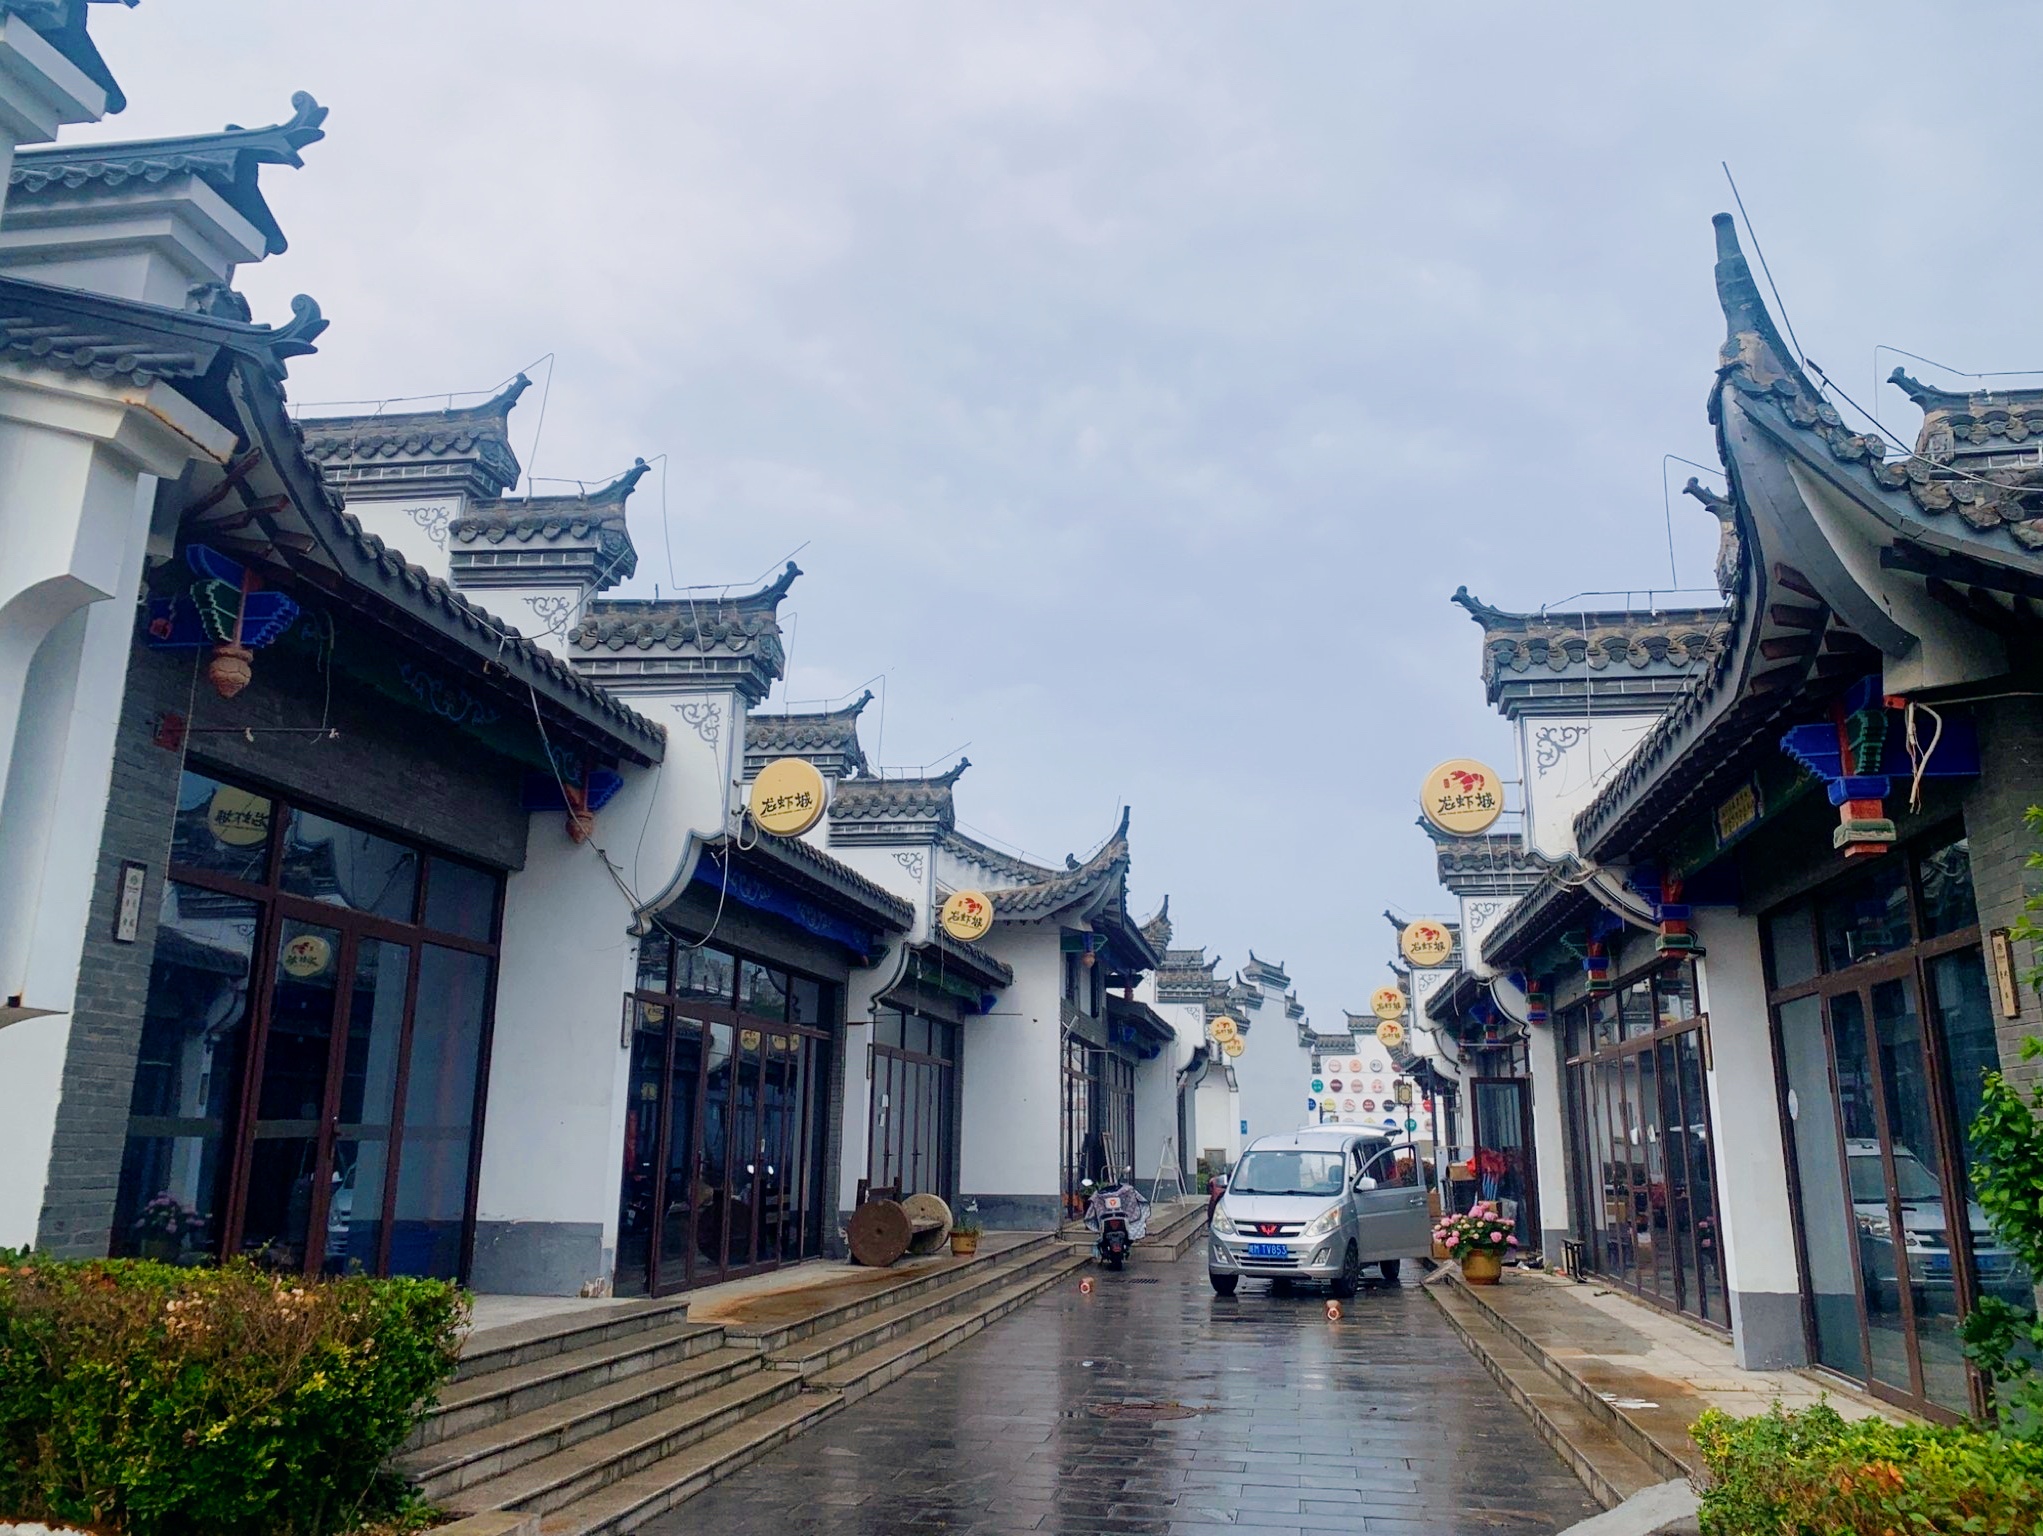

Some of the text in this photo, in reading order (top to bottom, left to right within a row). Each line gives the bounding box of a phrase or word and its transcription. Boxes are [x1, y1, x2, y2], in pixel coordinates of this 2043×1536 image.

[760, 791, 813, 816] 龙虾城
[1437, 792, 1495, 814] 龙虾城
